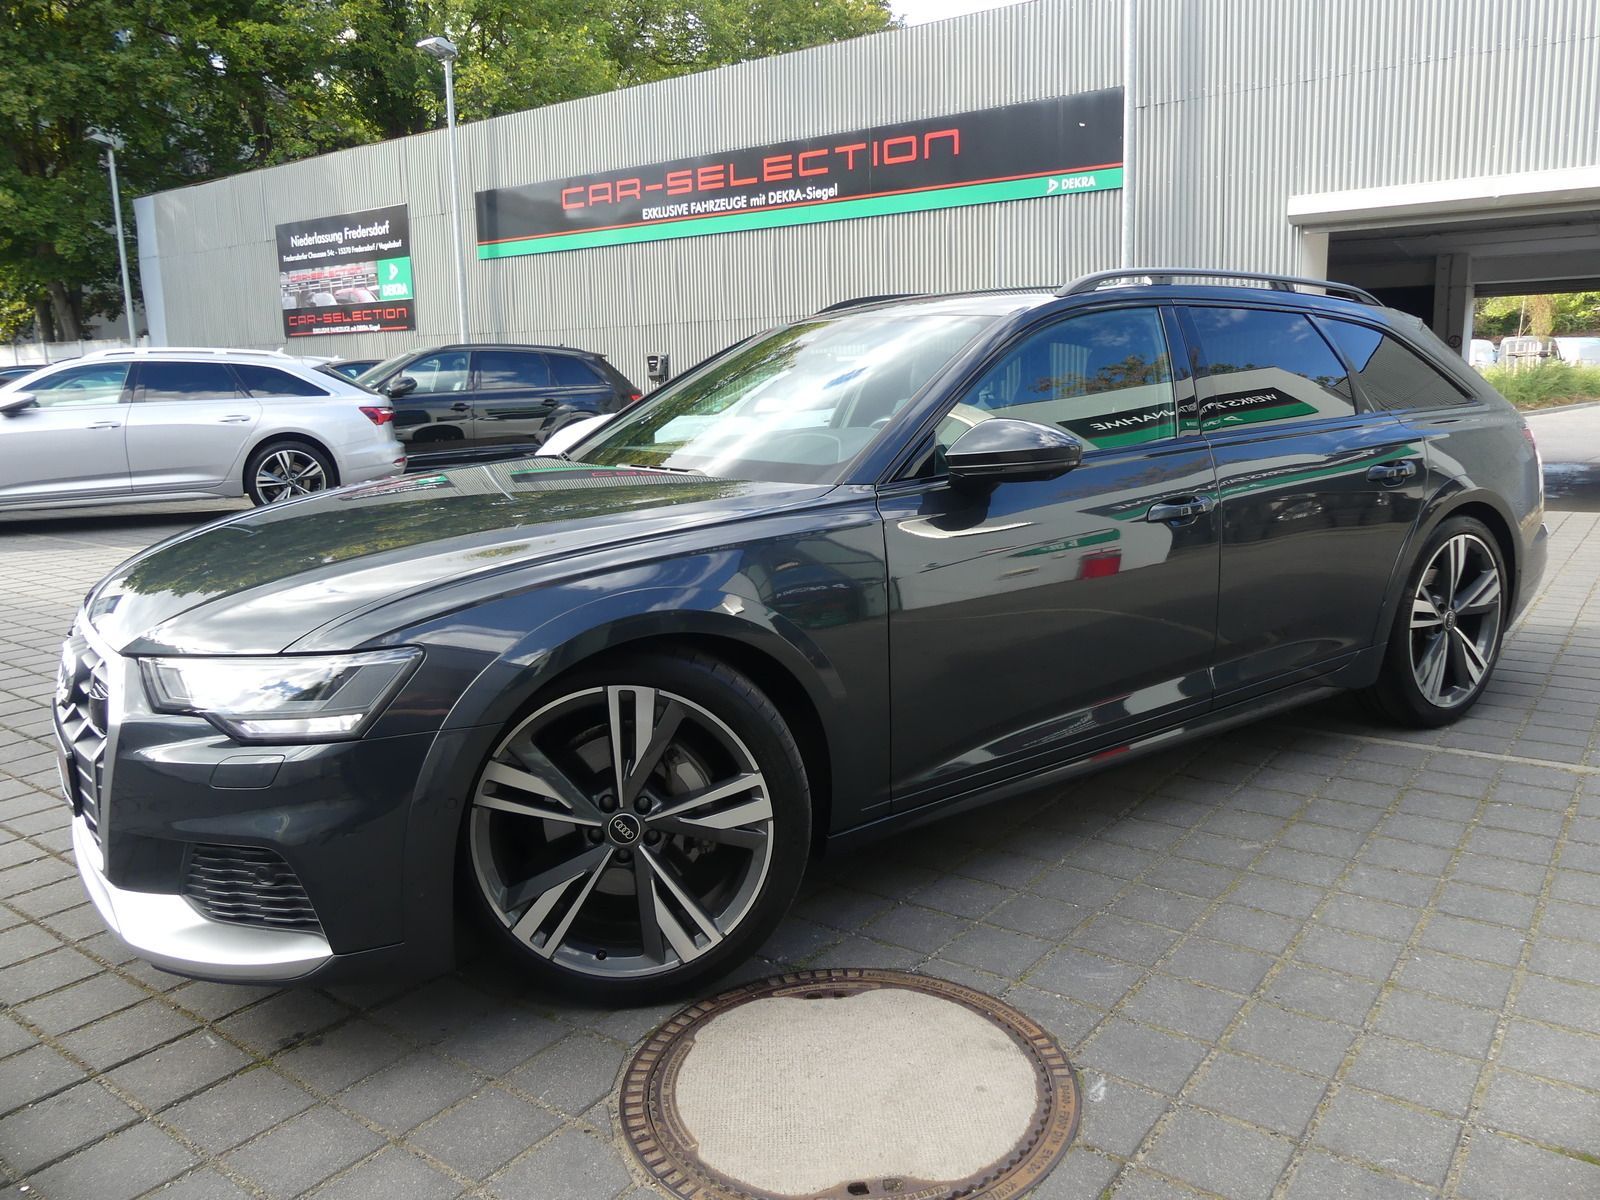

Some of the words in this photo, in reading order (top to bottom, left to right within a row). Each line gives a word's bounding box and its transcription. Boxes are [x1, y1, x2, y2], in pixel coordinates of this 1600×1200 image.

[561, 128, 959, 210] CAR-SELECTION
[1061, 175, 1096, 190] DEKRA
[642, 202, 689, 220] EXKLUSIVE
[690, 196, 747, 216] FAHRZEUGE
[750, 193, 767, 207] mit
[768, 183, 838, 205] DEKRA-Siegel
[290, 231, 343, 247] Niederlassung
[344, 220, 390, 240] Fredersdorf
[288, 307, 407, 326] CAR-SELECTION
